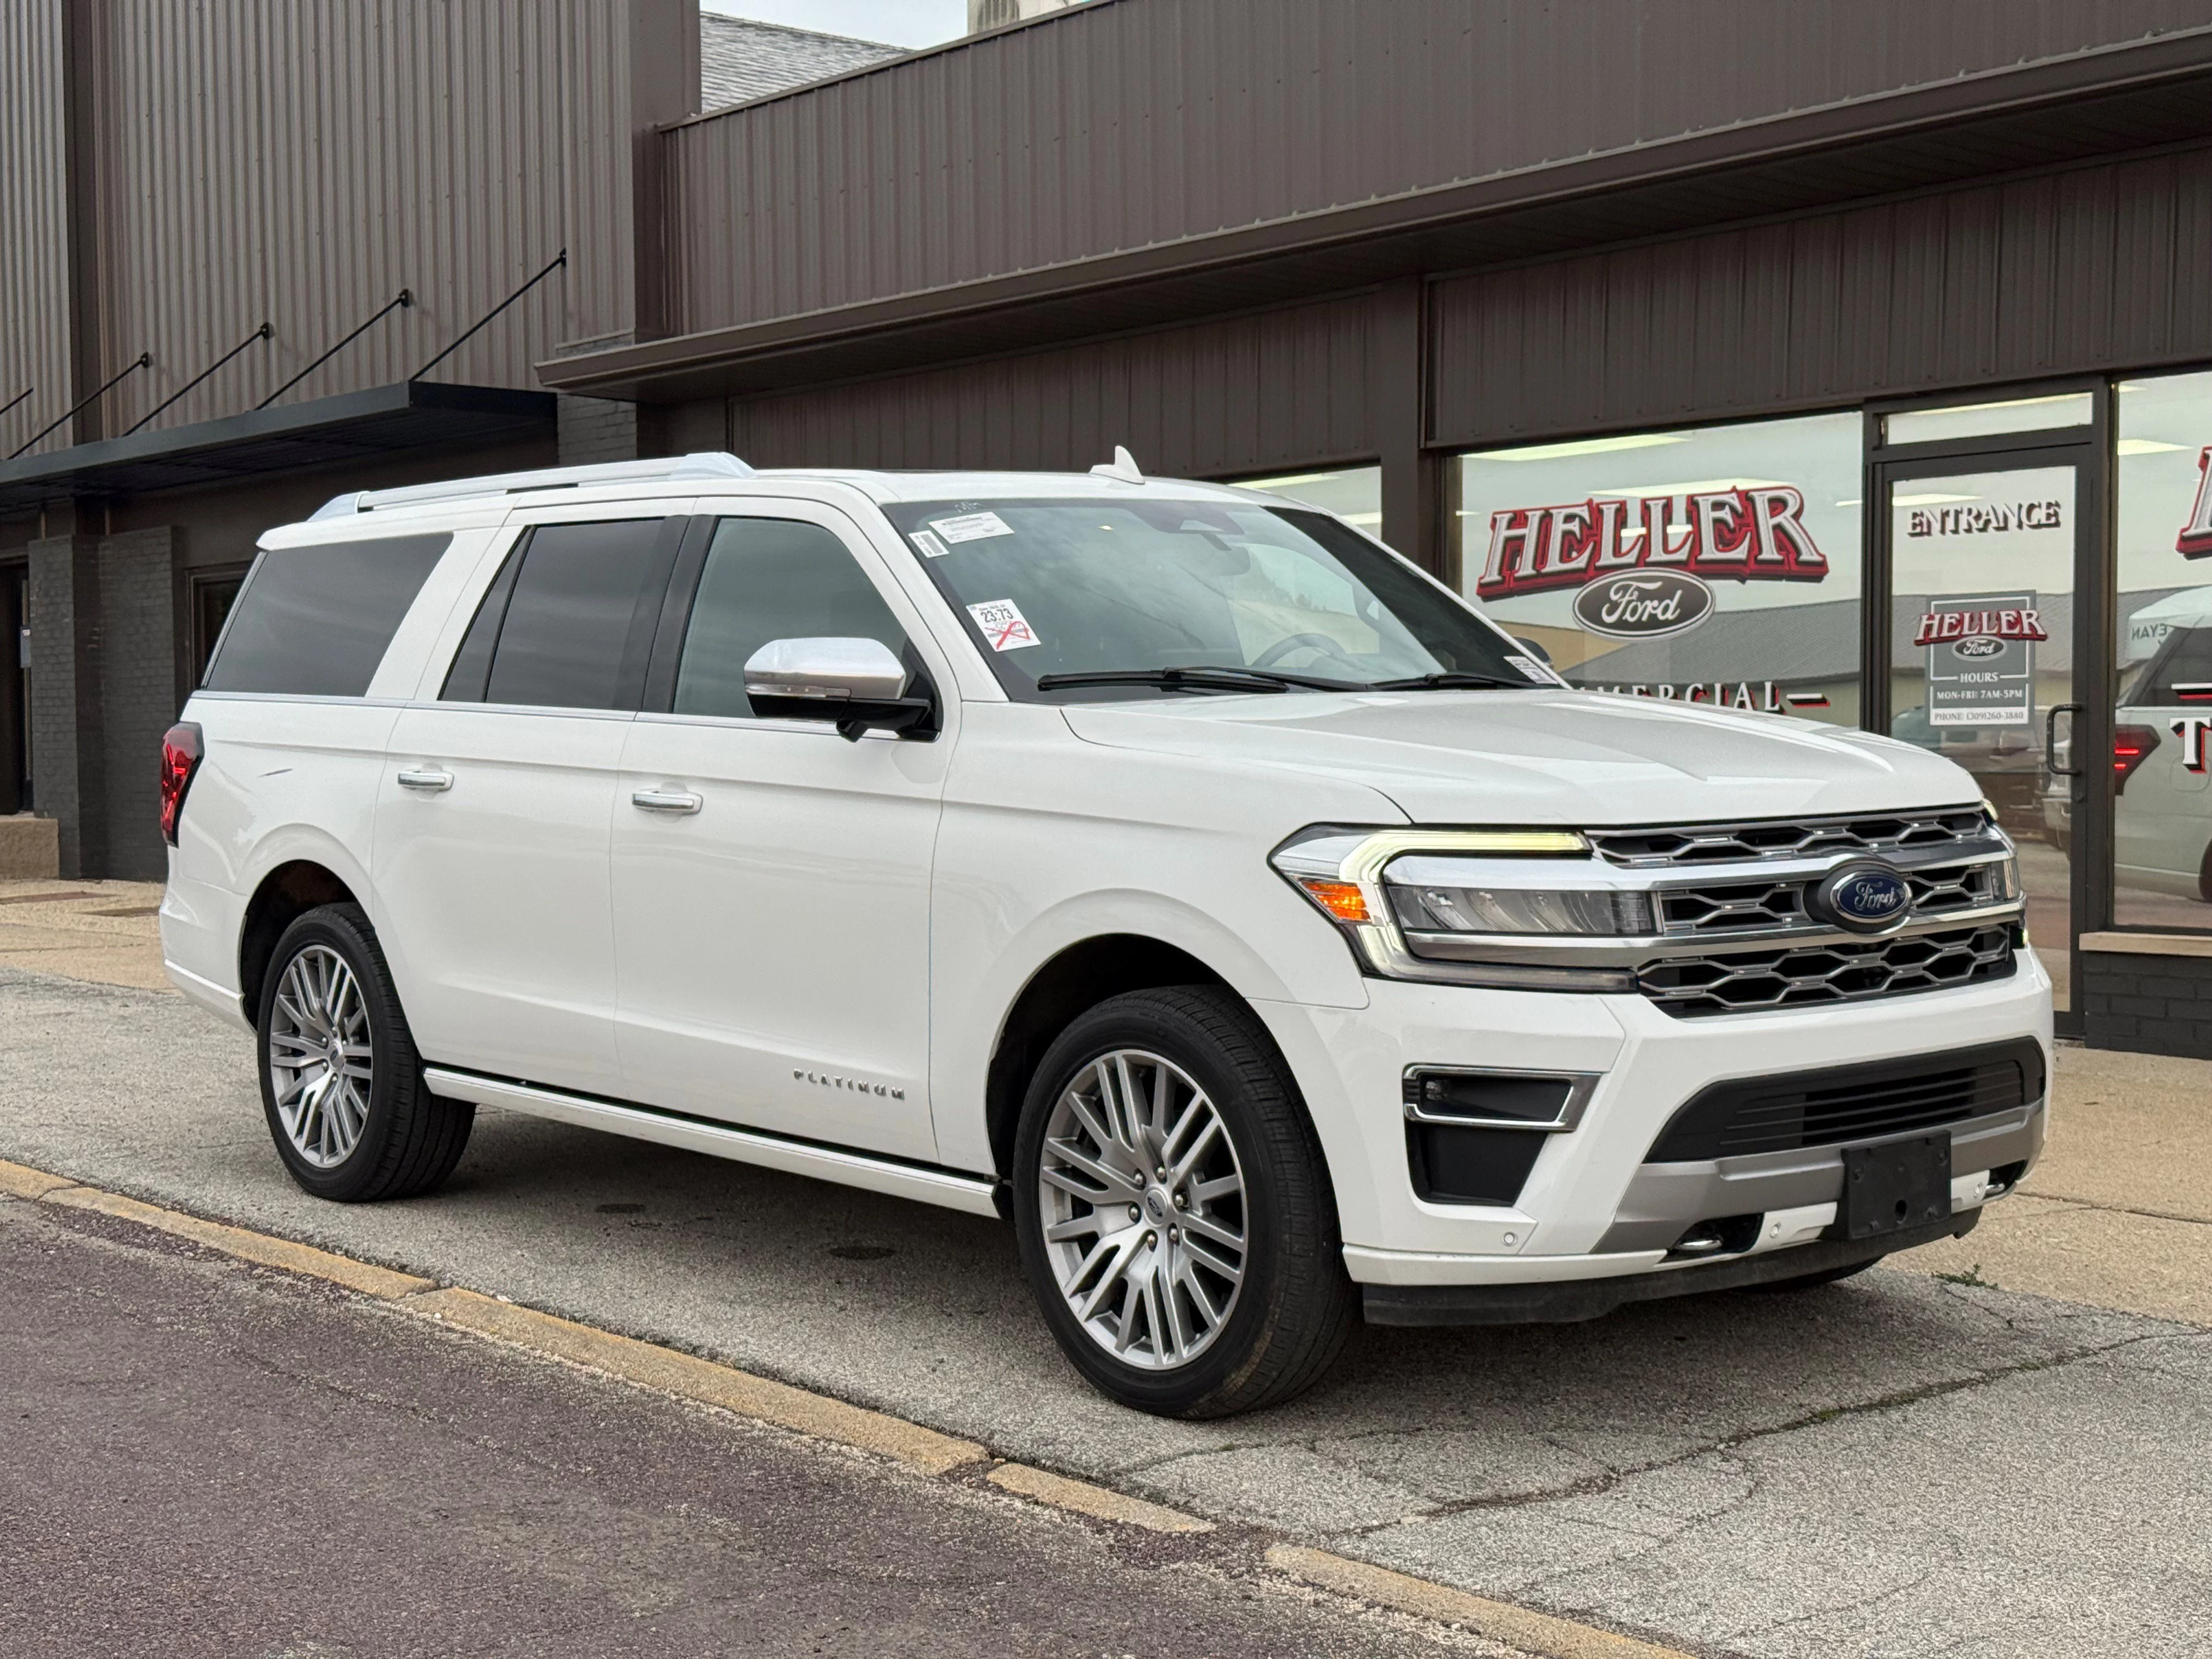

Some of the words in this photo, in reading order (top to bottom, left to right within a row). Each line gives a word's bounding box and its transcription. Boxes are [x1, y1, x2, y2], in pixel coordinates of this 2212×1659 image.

[1906, 499, 2061, 537] ENTRANCE
[1477, 486, 1829, 601] HELLER
[1601, 580, 1683, 624] Ford
[1913, 608, 2048, 647] HELLER
[1963, 639, 1996, 655] Ford
[1960, 672, 1999, 684] HOURS
[1980, 689, 2023, 699] 7AM-5PM
[1854, 881, 1897, 911] Ford
[793, 1068, 905, 1101] PLATINUM
